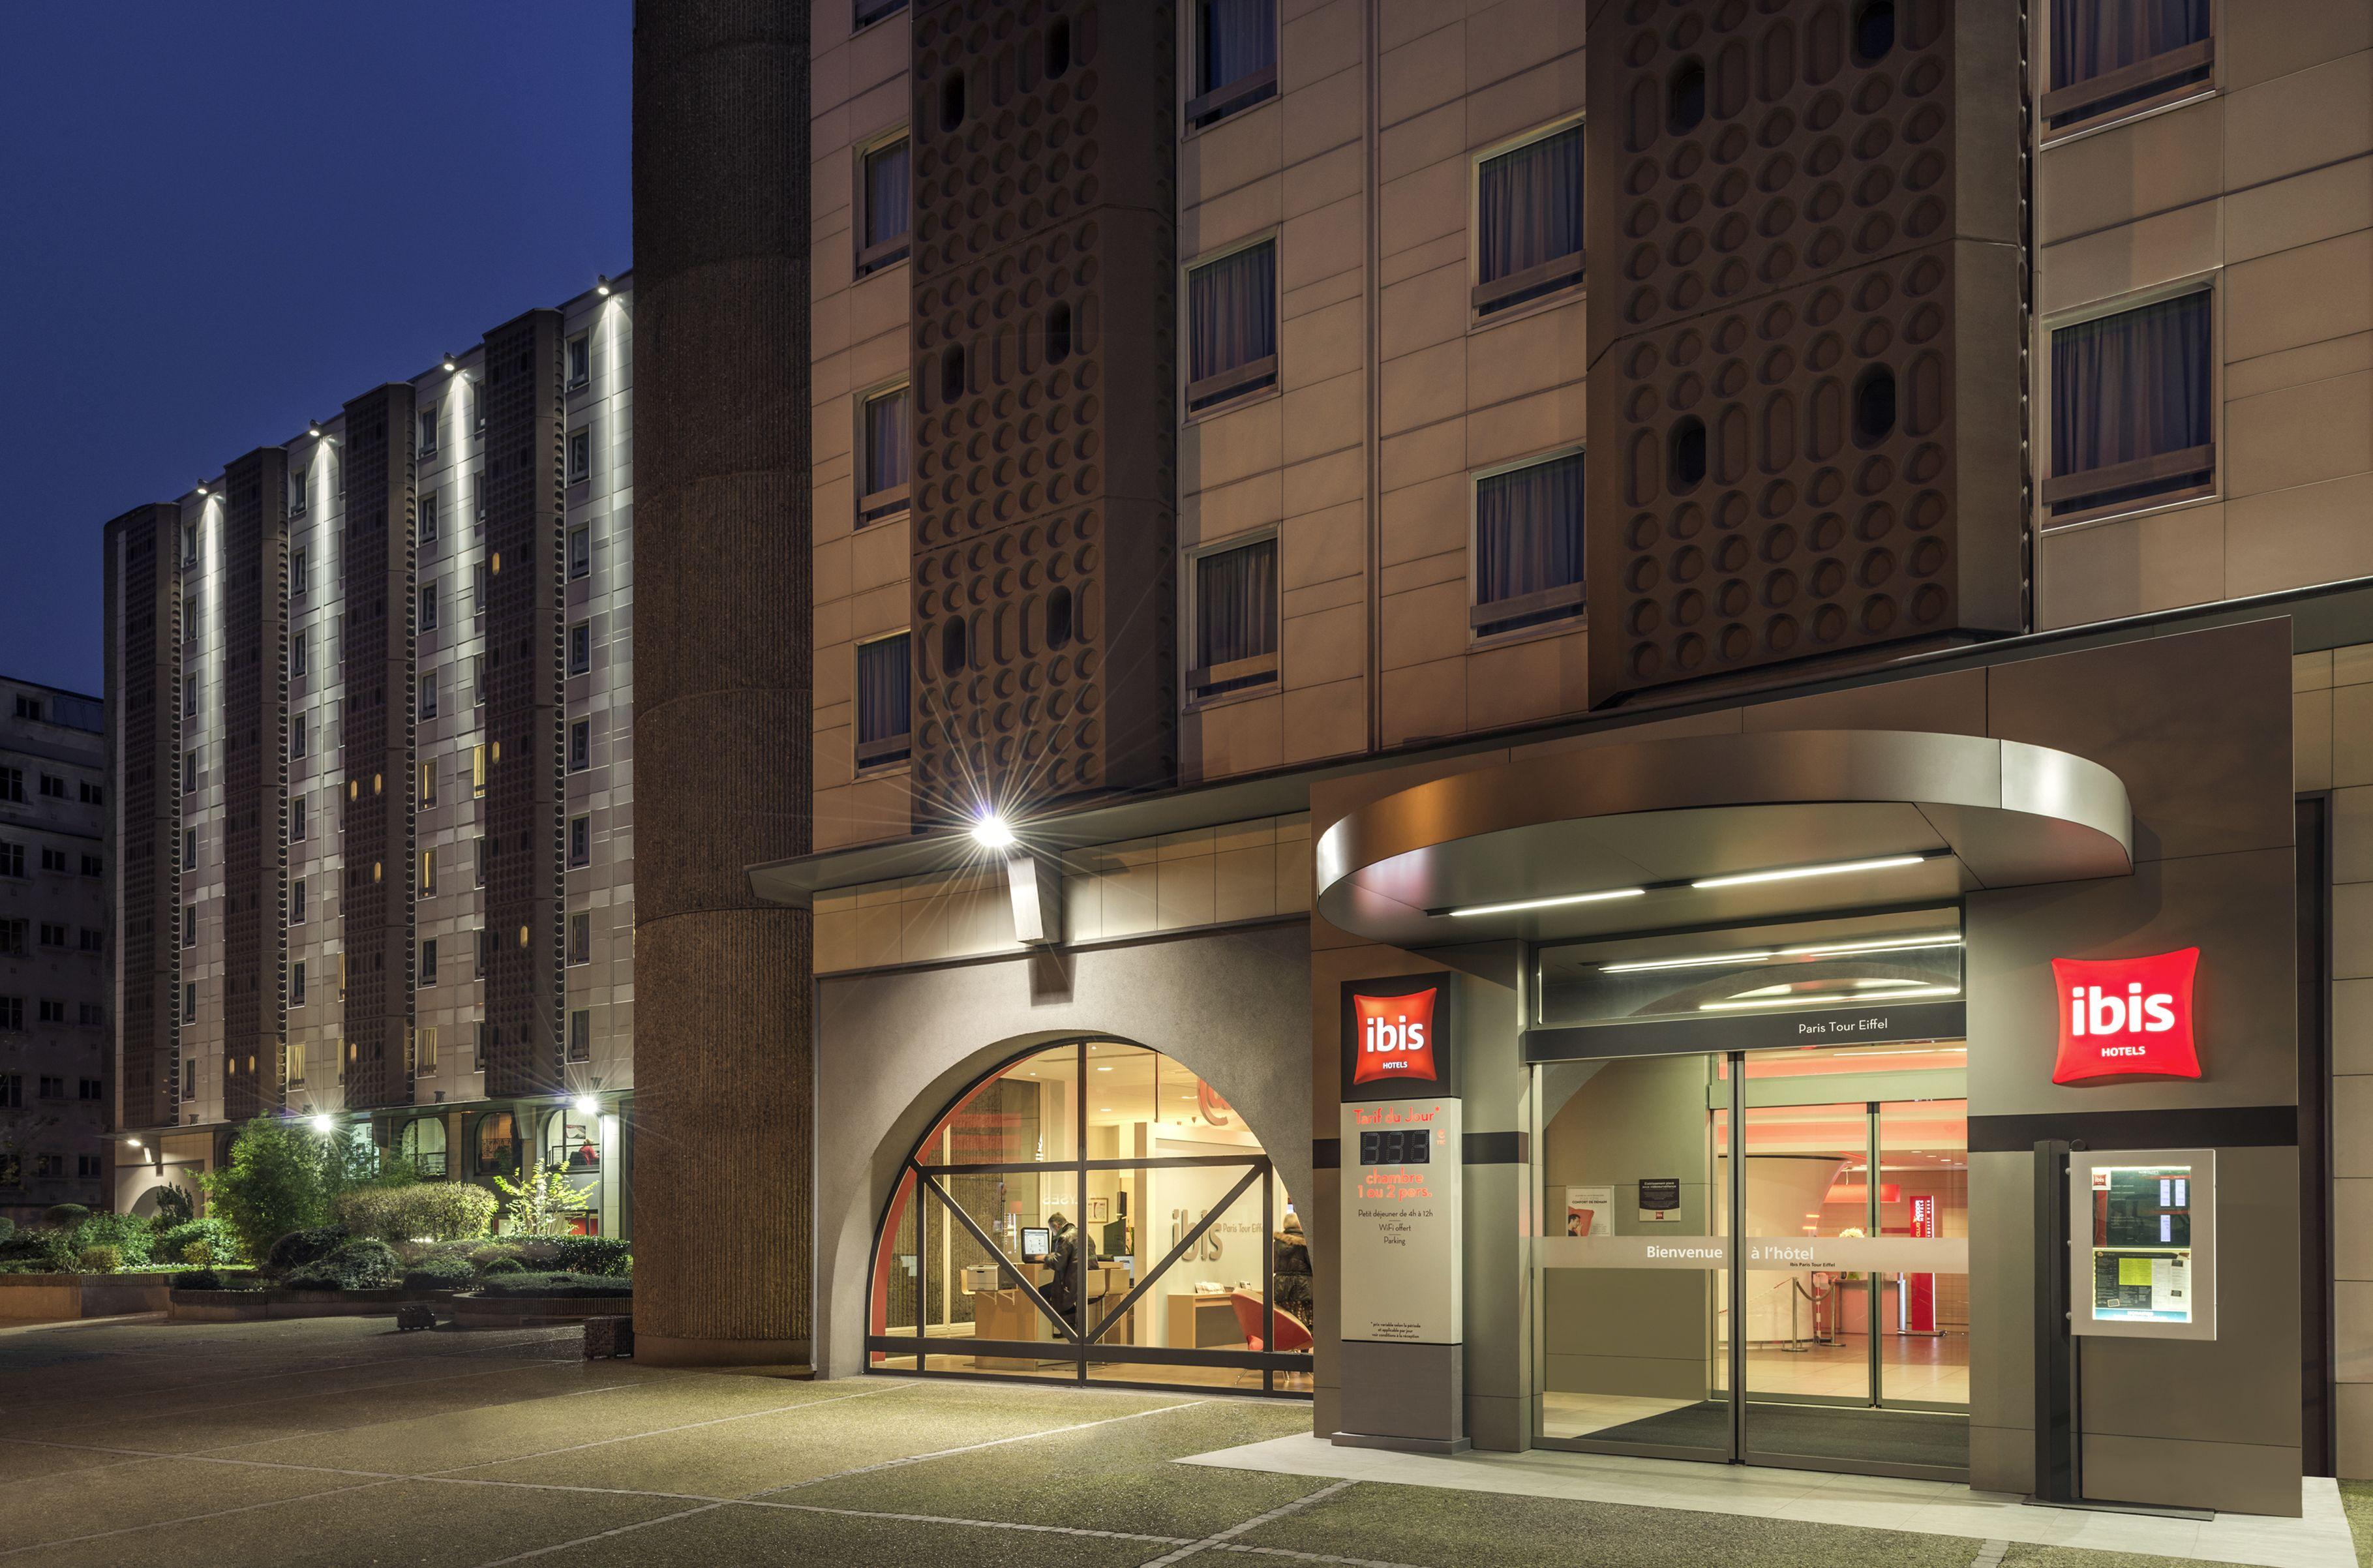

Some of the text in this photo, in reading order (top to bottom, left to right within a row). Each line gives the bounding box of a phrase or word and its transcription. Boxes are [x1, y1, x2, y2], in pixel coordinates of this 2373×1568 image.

[2072, 982, 2175, 1036] ibis
[1367, 1016, 1424, 1052] ibis
[1799, 1018, 1888, 1034] Paris Tour Eiffel
[2102, 1046, 2146, 1057] HOTELS
[1353, 1107, 1383, 1124] Tarif
[1385, 1106, 1401, 1124] du
[1366, 1167, 1424, 1184] chambre
[1357, 1184, 1432, 1201] 1 ou 2 pers.
[1372, 1209, 1398, 1219] déjeuner
[1173, 1209, 1223, 1261] ibis
[1223, 1223, 1237, 1233] Paris
[1239, 1224, 1250, 1233] Tour
[1383, 1237, 1406, 1246] Parking
[1646, 1245, 1813, 1260] Bienvenue à l'hôtel
